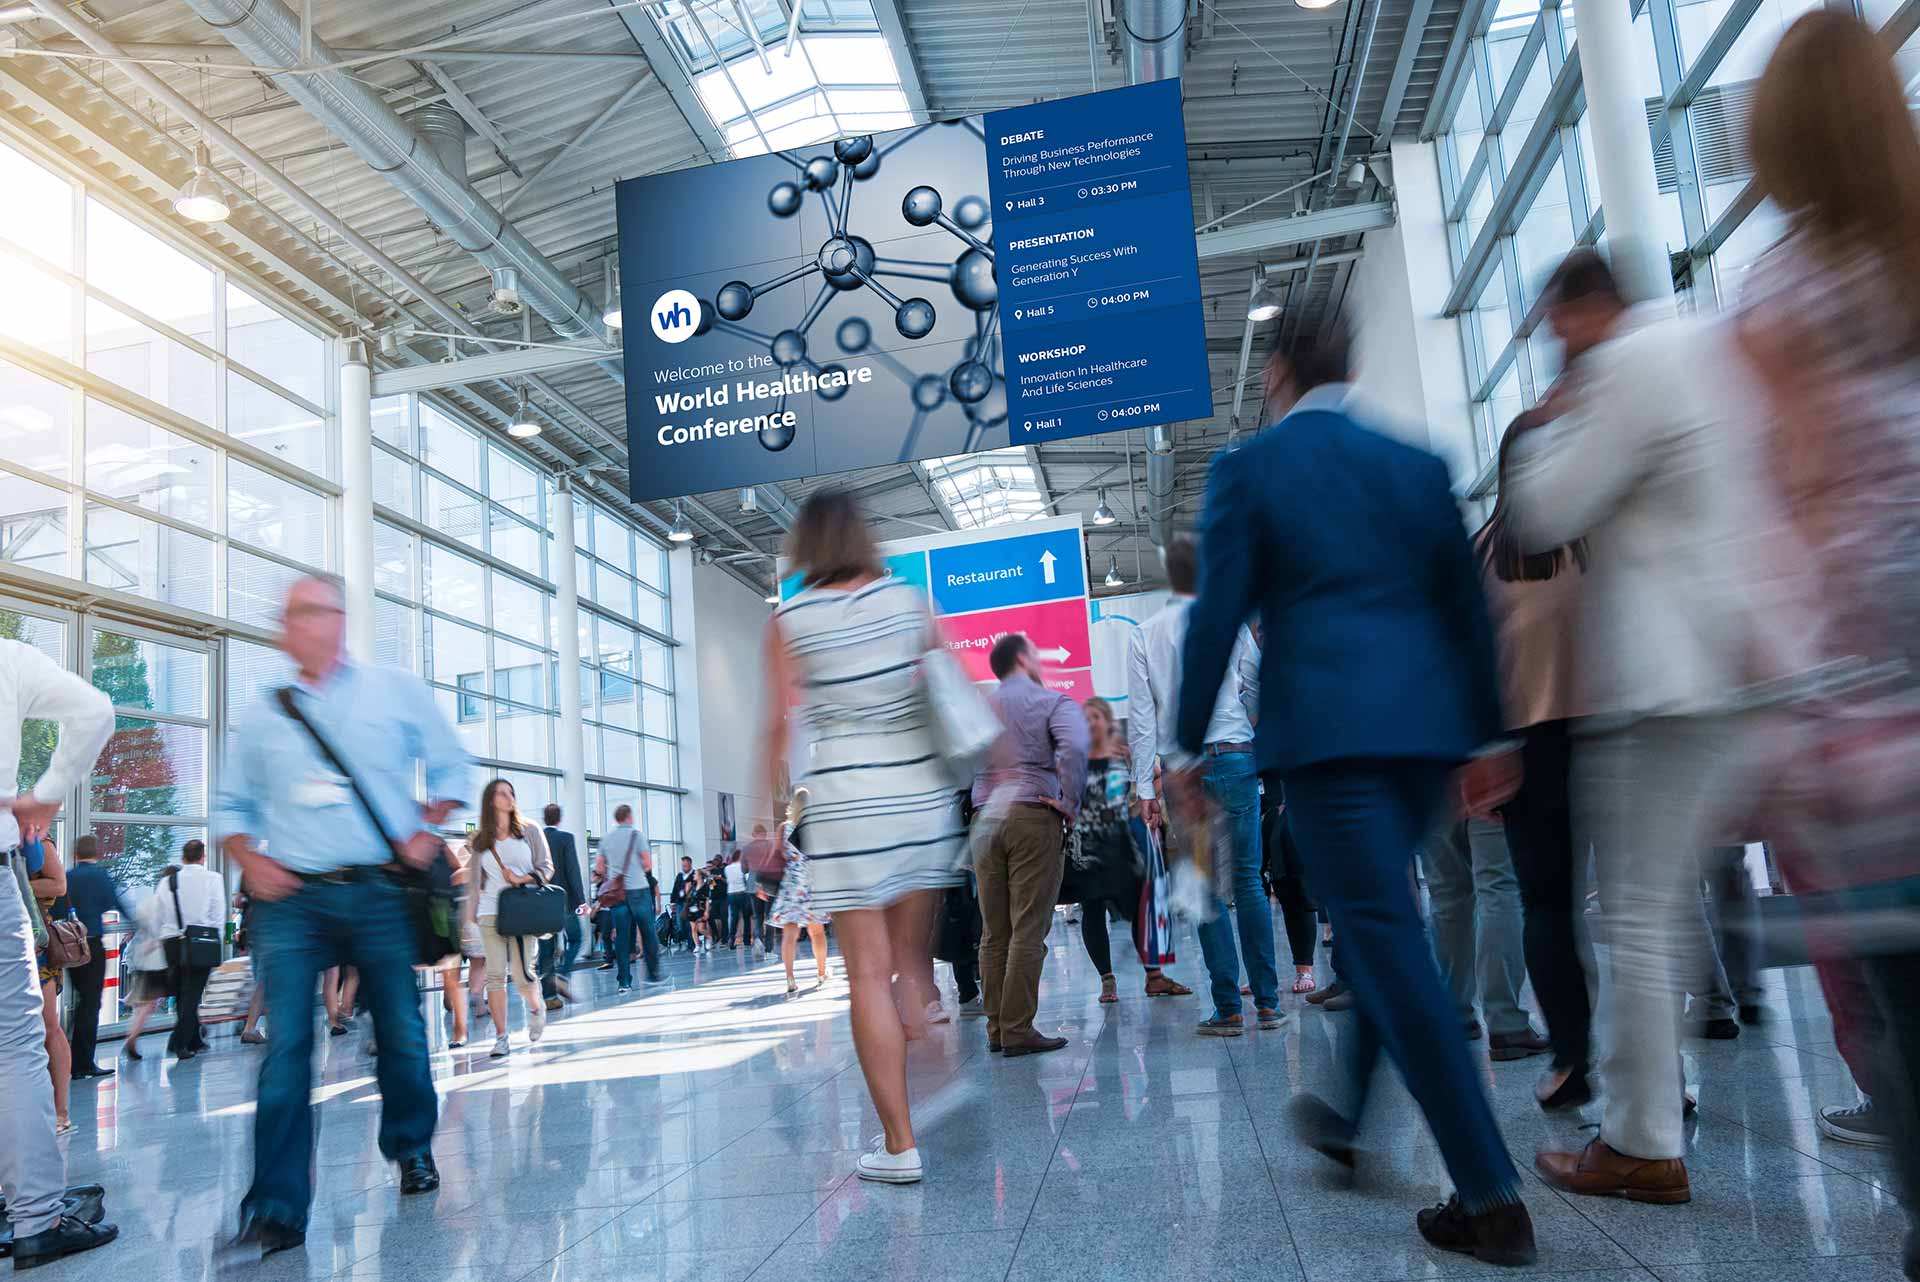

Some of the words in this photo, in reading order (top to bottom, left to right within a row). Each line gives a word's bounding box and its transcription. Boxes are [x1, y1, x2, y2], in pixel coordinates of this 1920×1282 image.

[1000, 130, 1045, 146] DEBATE
[1002, 152, 1038, 167] Driving
[1040, 144, 1085, 160] Business
[1087, 131, 1154, 151] Performance
[1003, 164, 1046, 179] Through
[1048, 160, 1071, 174] New
[1072, 147, 1141, 168] Technologies
[1091, 183, 1119, 196] 03:30
[1121, 180, 1137, 192] PM
[1017, 198, 1036, 209] Hall
[1038, 197, 1045, 206] 3
[1009, 228, 1095, 251] PRESENTATION
[1011, 255, 1069, 275] Generating
[1070, 249, 1111, 265] Success
[1113, 244, 1138, 257] With
[1012, 269, 1070, 288] Generation
[1071, 267, 1079, 277] Y
[1101, 293, 1131, 306] 04:00
[1133, 289, 1150, 301] PM
[657, 302, 691, 331] wh
[1026, 307, 1046, 319] Hall
[1047, 305, 1055, 315] 5
[1018, 344, 1087, 364] WORKSHOP
[654, 359, 724, 384] Welcome
[727, 358, 744, 372] to
[748, 353, 774, 369] the
[1020, 368, 1076, 385] Innovation
[1078, 366, 1088, 376] In
[1090, 357, 1148, 375] Healthcare
[654, 383, 729, 415] World
[736, 366, 873, 403] Healthcare
[1021, 387, 1043, 398] And
[1045, 382, 1065, 395] Life
[1066, 376, 1113, 392] Sciences
[1111, 406, 1141, 419] 04:00
[1143, 403, 1161, 414] PM
[657, 409, 797, 446] Conference
[1036, 419, 1056, 430] Hall
[1057, 418, 1063, 427] 1
[946, 564, 1024, 588] Restaurant
